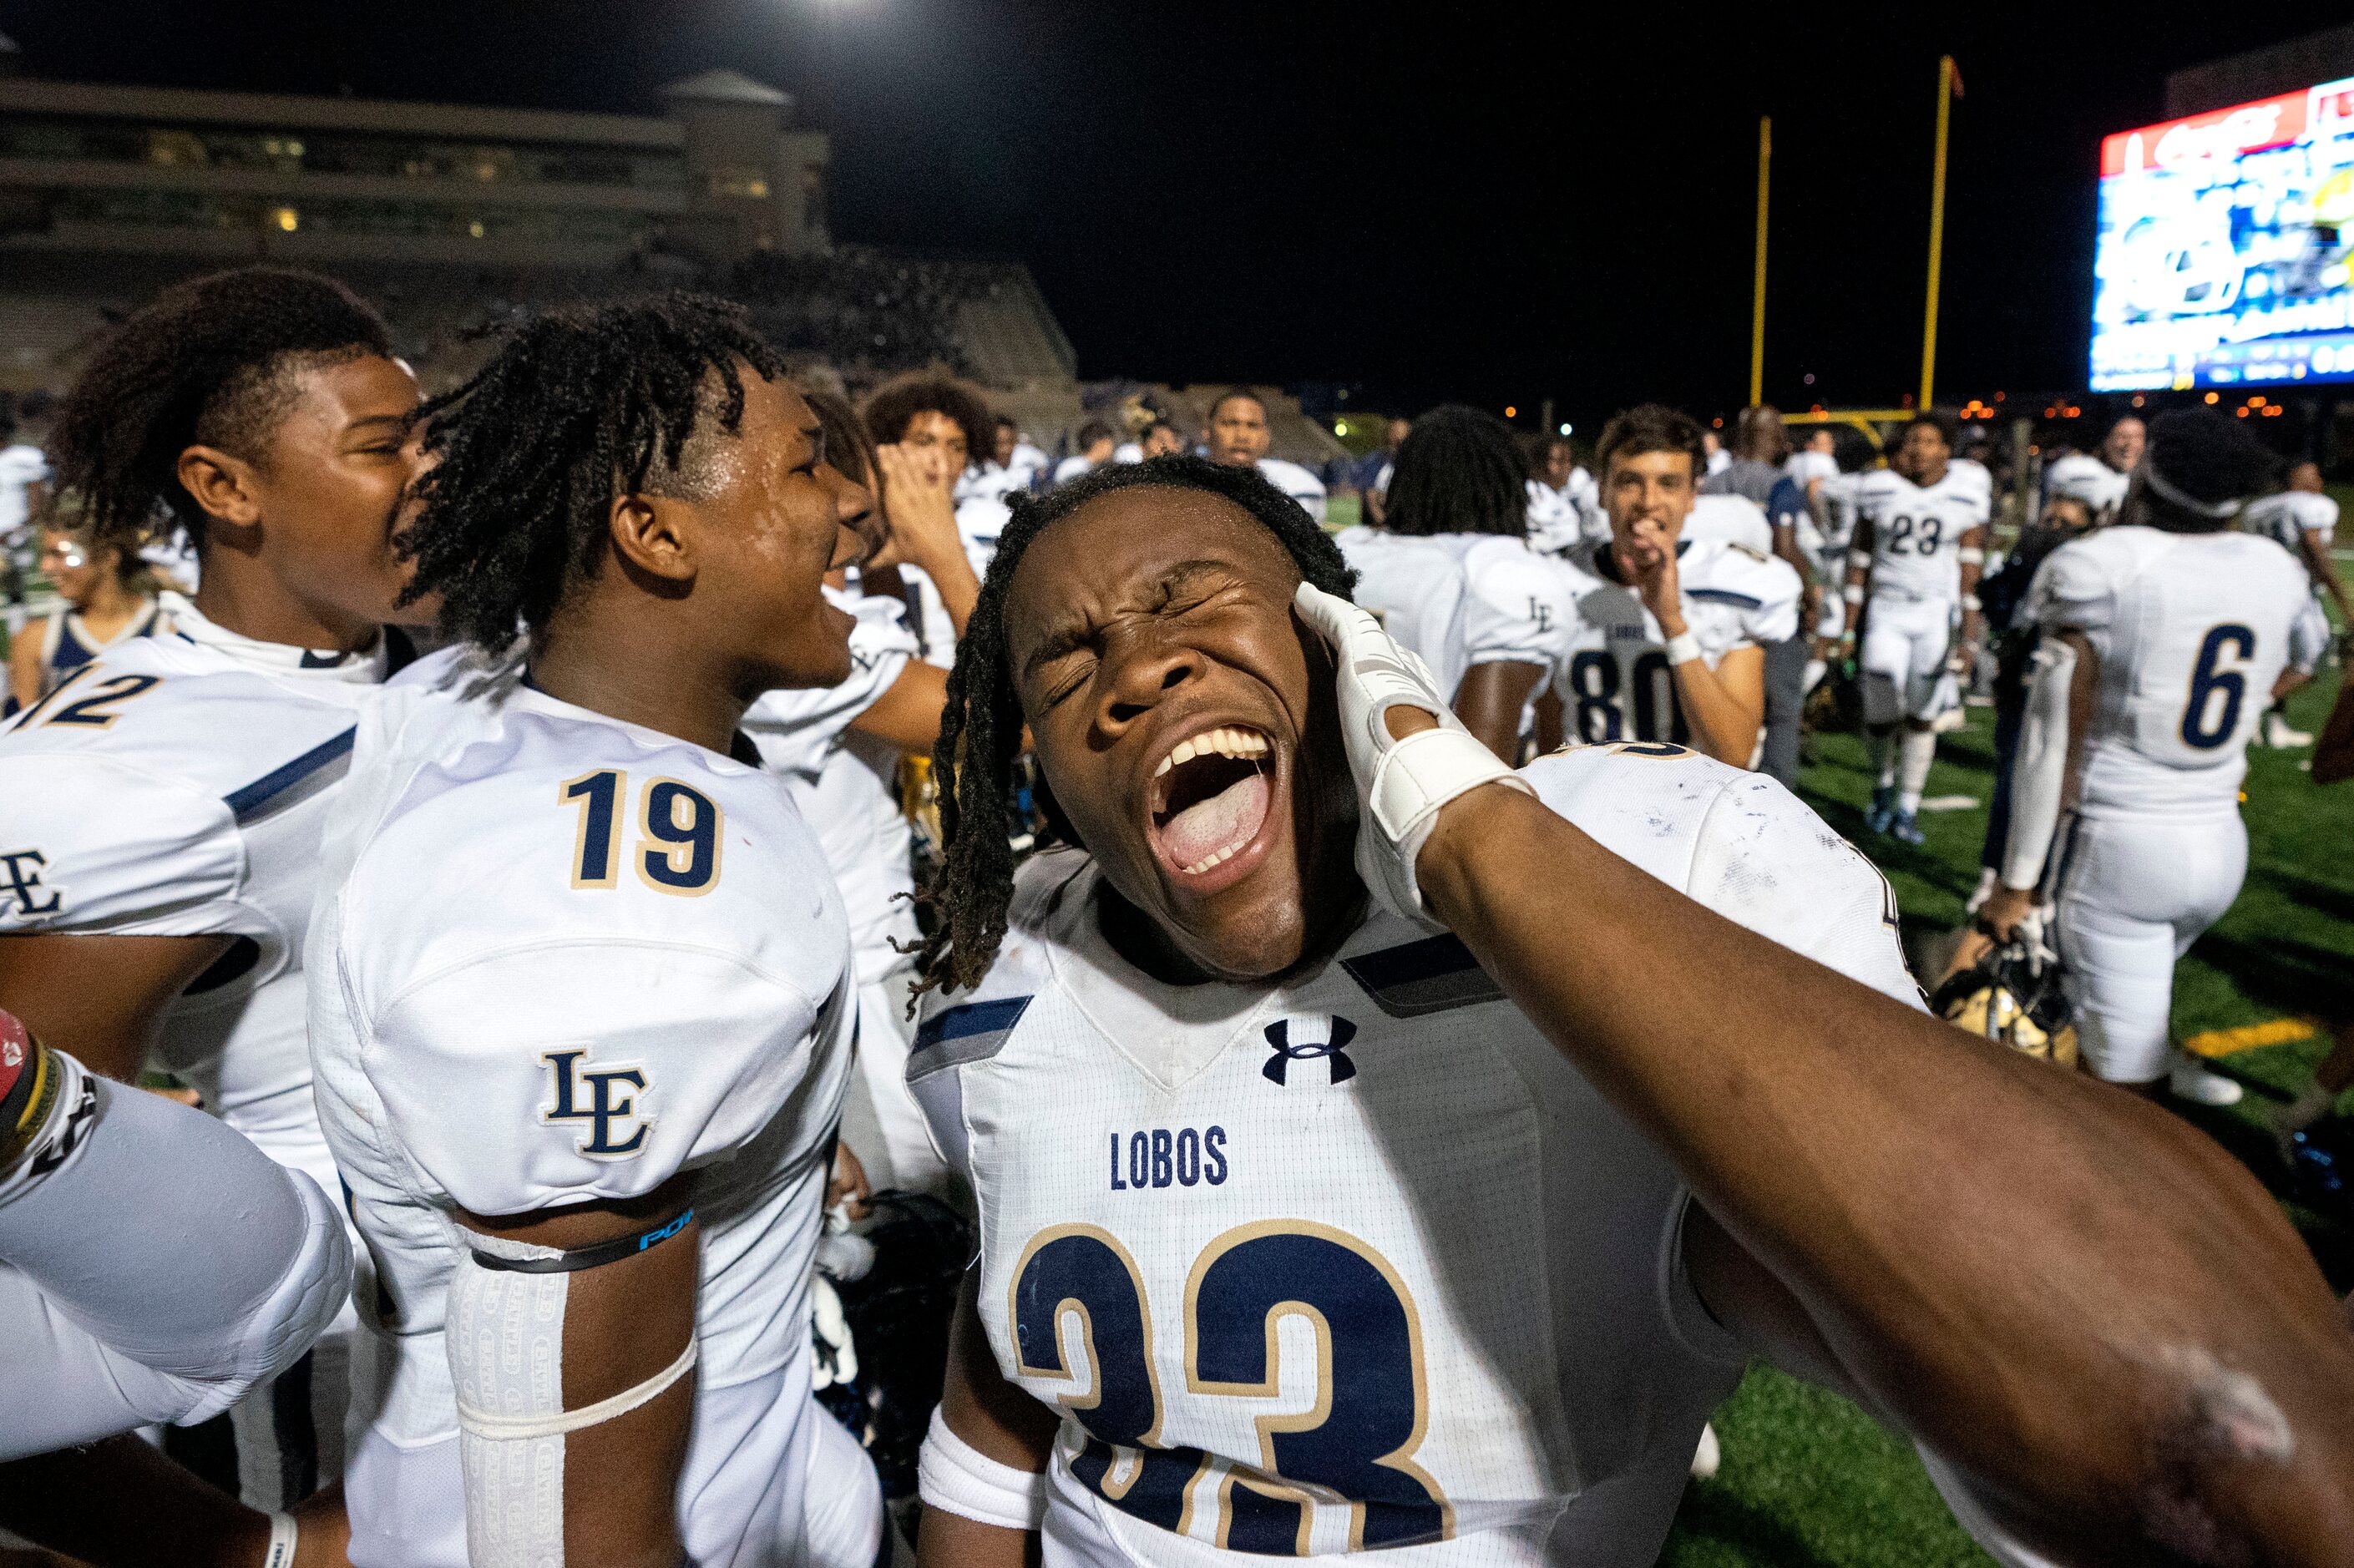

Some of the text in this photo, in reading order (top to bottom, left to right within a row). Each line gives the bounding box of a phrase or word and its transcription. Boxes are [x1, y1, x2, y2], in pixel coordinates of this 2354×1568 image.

[1891, 514, 1941, 556] 23
[1570, 647, 1689, 745] 80
[2177, 621, 2256, 750] 6
[557, 767, 725, 898] 19
[541, 1048, 650, 1156] LE
[1111, 1125, 1228, 1191] LOBOS
